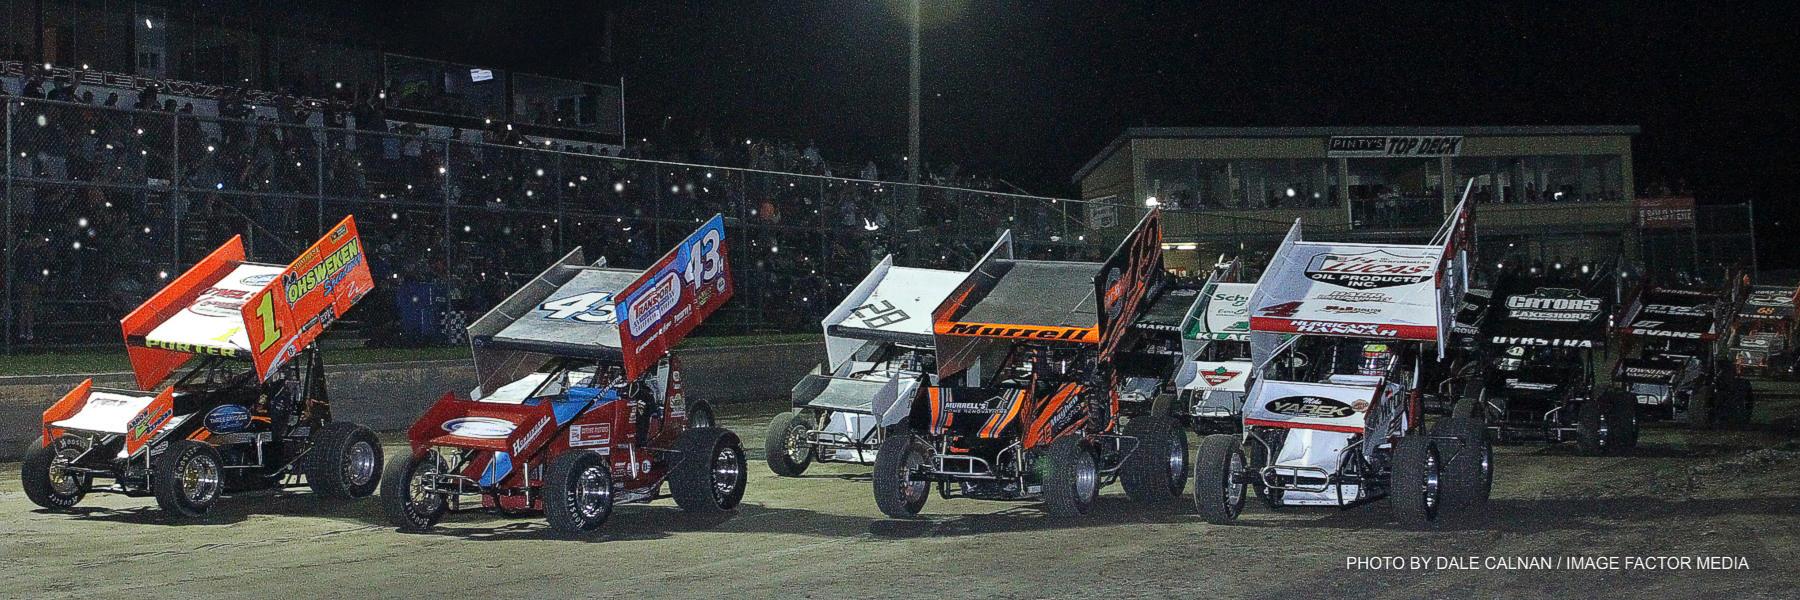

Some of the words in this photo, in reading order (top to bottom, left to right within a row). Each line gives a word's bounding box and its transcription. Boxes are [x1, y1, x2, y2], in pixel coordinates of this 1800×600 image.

[1333, 138, 1384, 149] PINTY'S
[1386, 137, 1419, 155] TOP
[1418, 137, 1462, 155] DECK
[287, 237, 359, 303] OHSWEKEN
[1321, 262, 1430, 274] LUCAS
[1339, 274, 1421, 283] PRODUCTS
[1347, 280, 1378, 288] INC.
[256, 288, 283, 354] 1
[948, 323, 1089, 341] Murrell
[1297, 325, 1397, 338] HANNAH
[1631, 328, 1703, 339] EVANS
[145, 338, 236, 357] PORTER
[944, 402, 987, 410] MURRELL'S
[1274, 401, 1350, 416] YAREK
